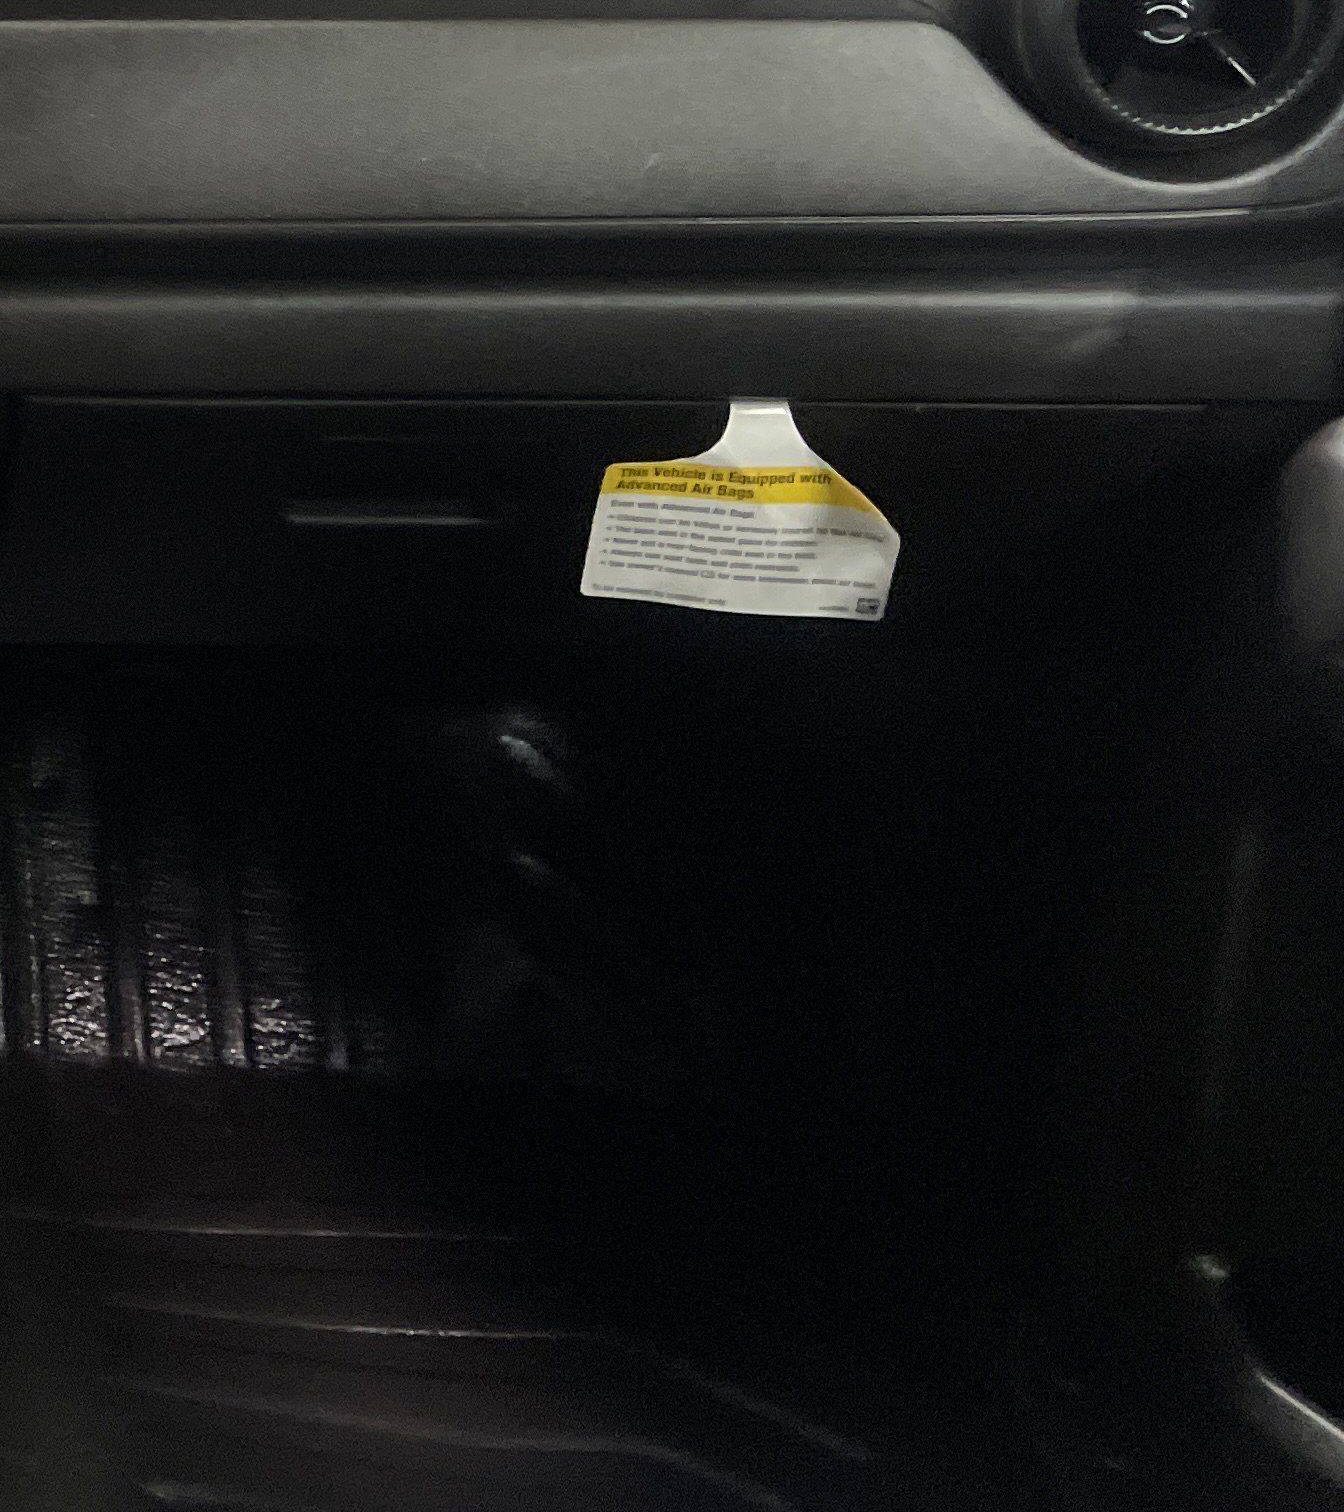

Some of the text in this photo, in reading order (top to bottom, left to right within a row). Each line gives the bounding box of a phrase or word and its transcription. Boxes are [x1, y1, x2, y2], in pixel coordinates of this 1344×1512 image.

[620, 467, 833, 486] This Vehicle is Equipped with
[615, 479, 754, 500] Advanced Air Bags
